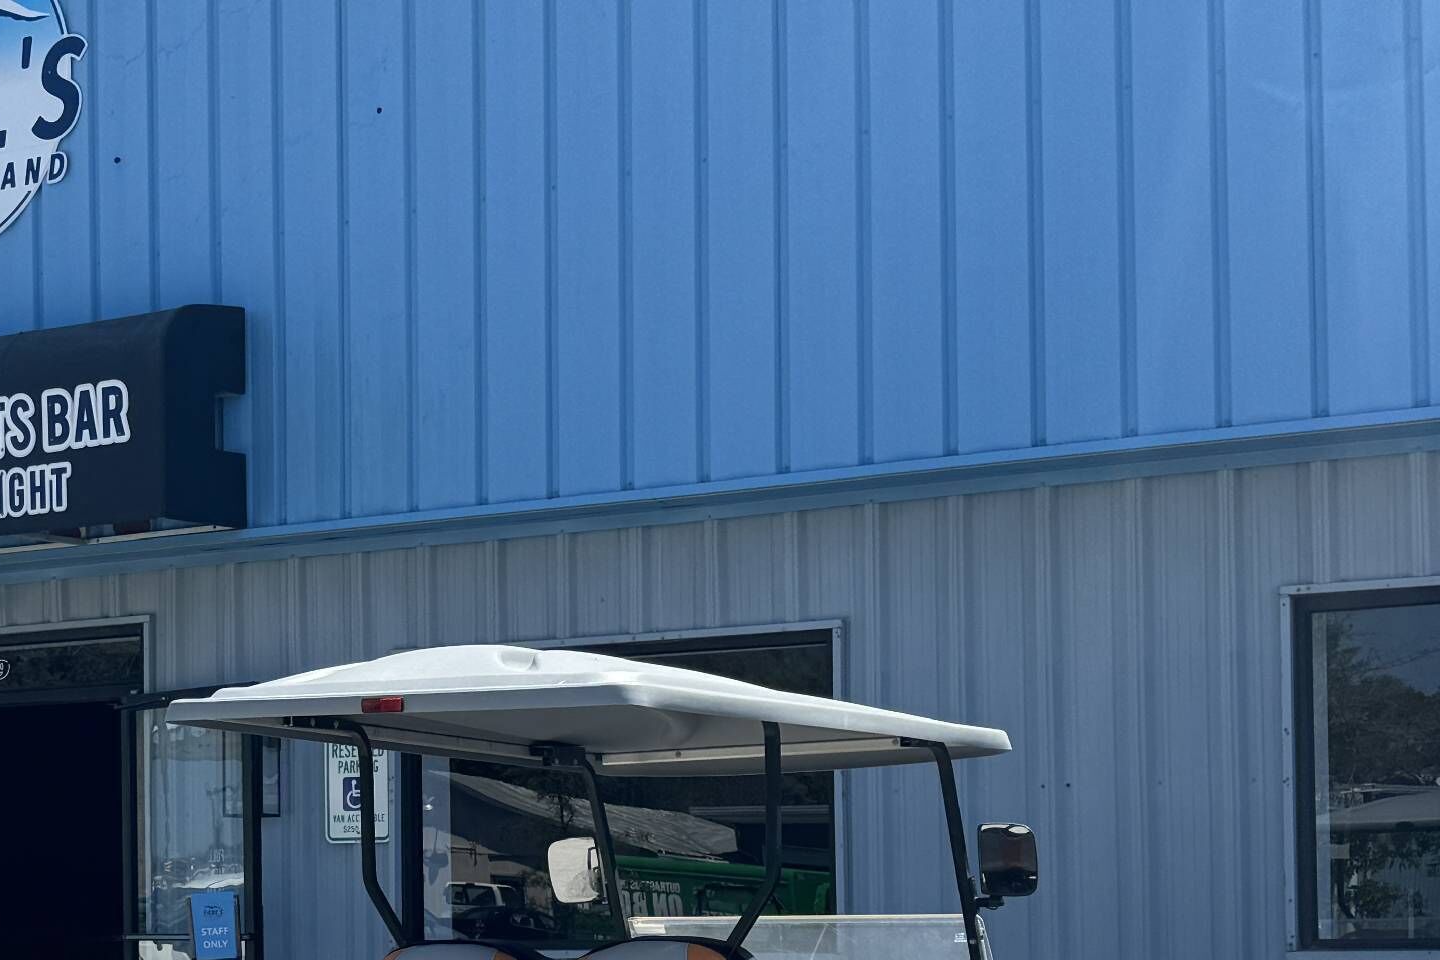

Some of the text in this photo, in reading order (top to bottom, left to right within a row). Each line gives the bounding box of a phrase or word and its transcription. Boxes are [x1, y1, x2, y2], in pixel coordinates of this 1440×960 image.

[41, 378, 131, 453] BAR
[331, 744, 384, 759] RESEED
[338, 760, 379, 774] PARKG
[332, 813, 385, 823] VAN ACCBLE
[201, 927, 229, 937] STAFF
[203, 940, 229, 949] ONLY
